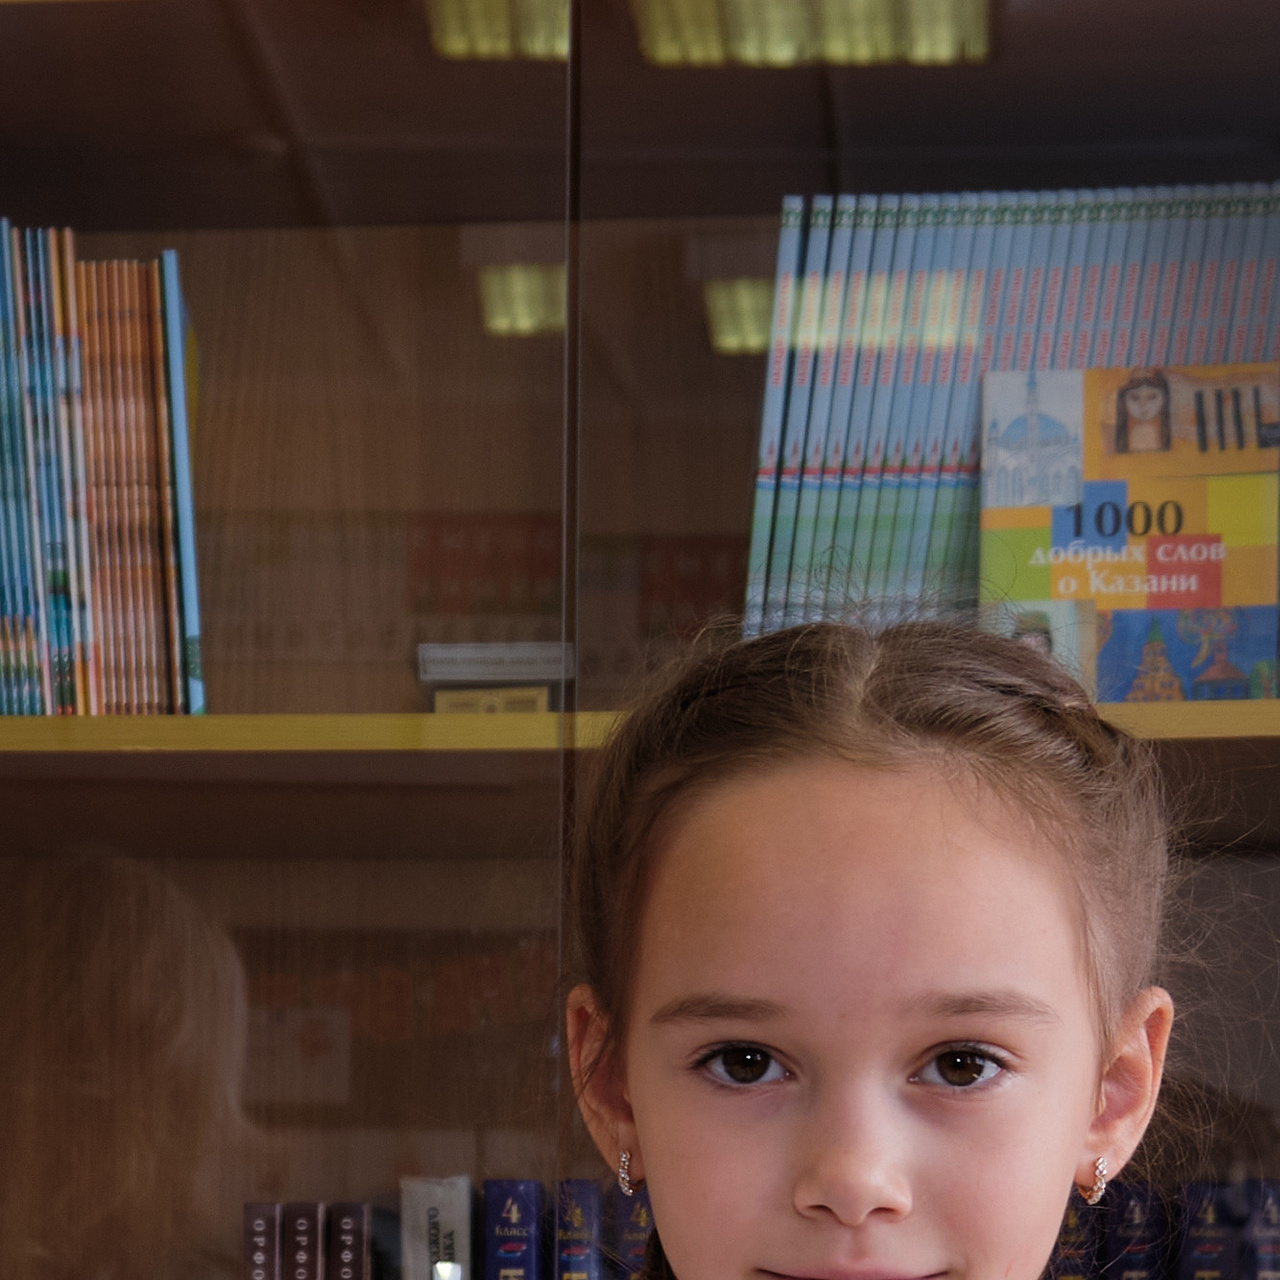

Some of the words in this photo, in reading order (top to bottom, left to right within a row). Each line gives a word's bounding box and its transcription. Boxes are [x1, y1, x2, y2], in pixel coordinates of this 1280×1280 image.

[1066, 500, 1184, 538] 1000
[1029, 540, 1145, 570] добрых
[1156, 542, 1227, 562] слов
[1058, 576, 1078, 595] о
[1089, 569, 1199, 594] Казани
[501, 1197, 522, 1224] 4
